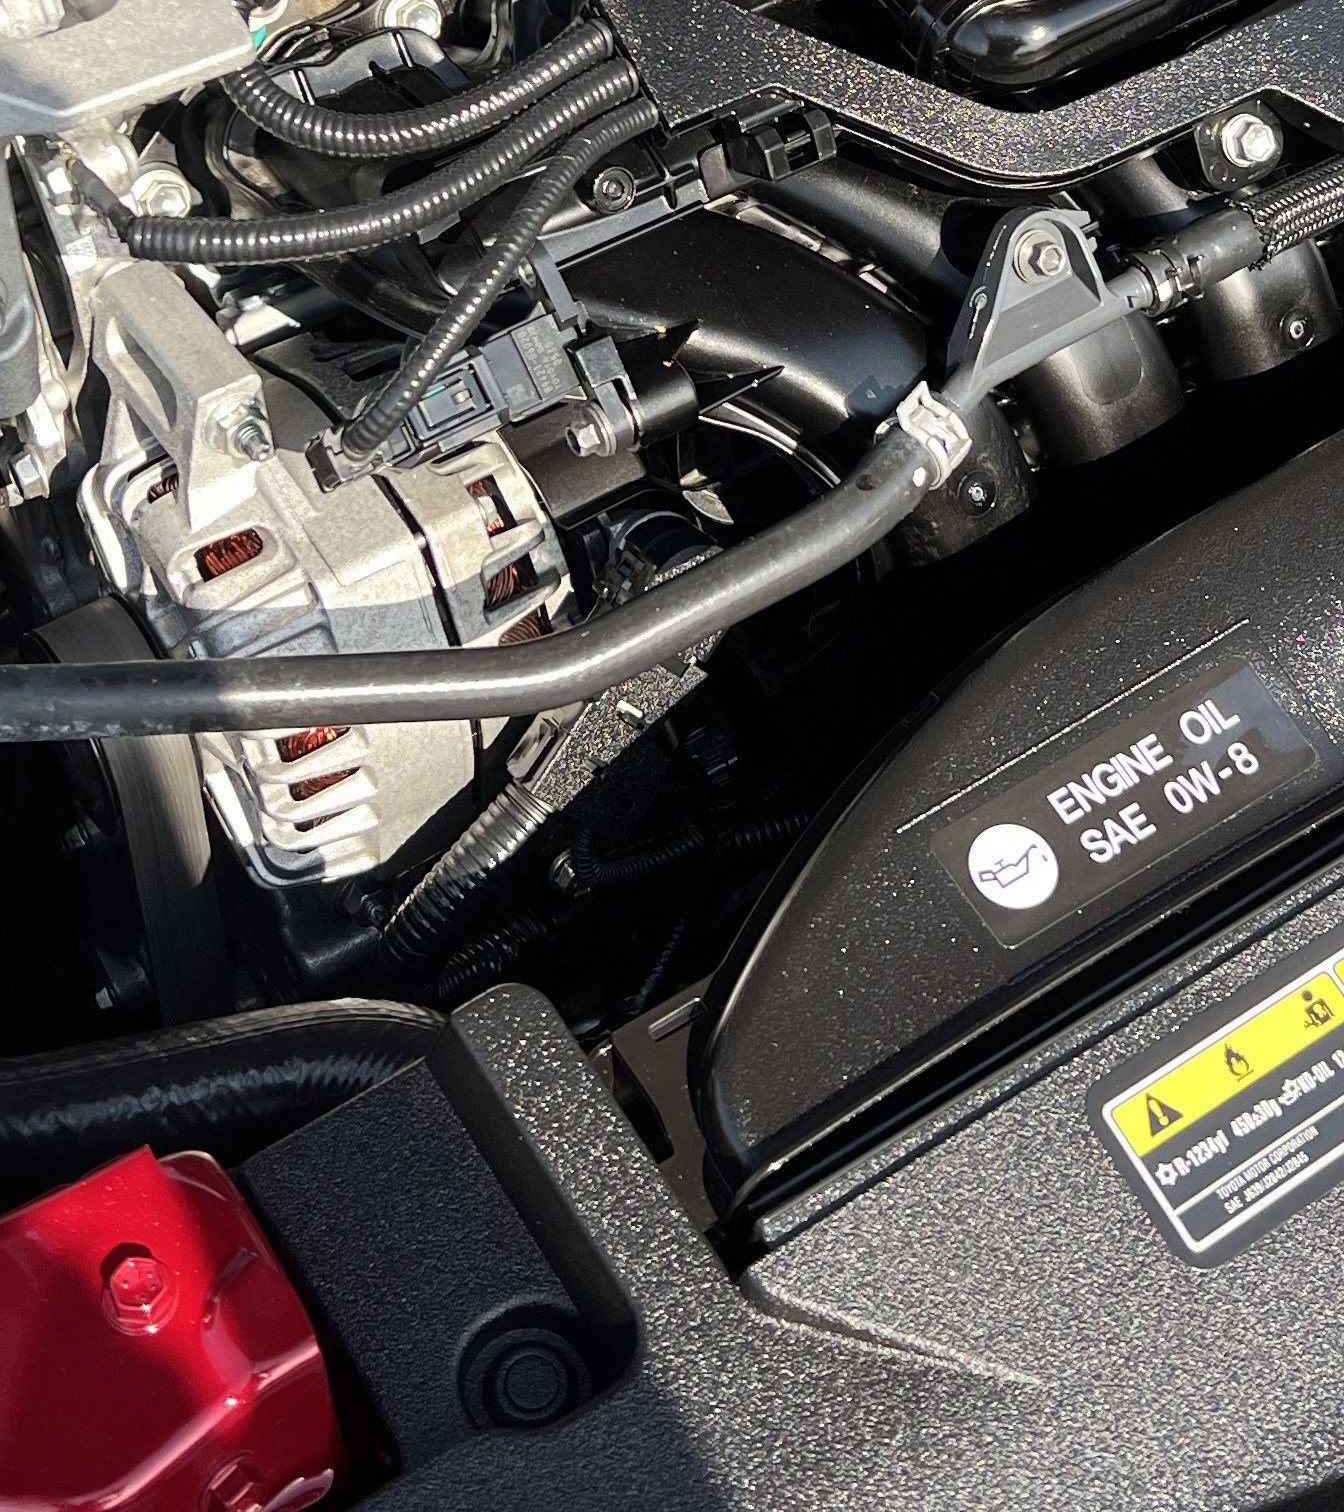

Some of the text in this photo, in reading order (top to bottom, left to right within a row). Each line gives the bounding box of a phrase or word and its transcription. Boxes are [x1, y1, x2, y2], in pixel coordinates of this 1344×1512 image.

[1047, 699, 1240, 825] ENGINE OIL
[1080, 742, 1259, 863] SAE 0W-8
[1172, 1129, 1229, 1176] R-1234yf
[1296, 1061, 1335, 1094] ND-OIL
[1215, 1125, 1319, 1200] TOYOTA MOTOR CORPORATION
[1224, 1196, 1244, 1214] SAE
